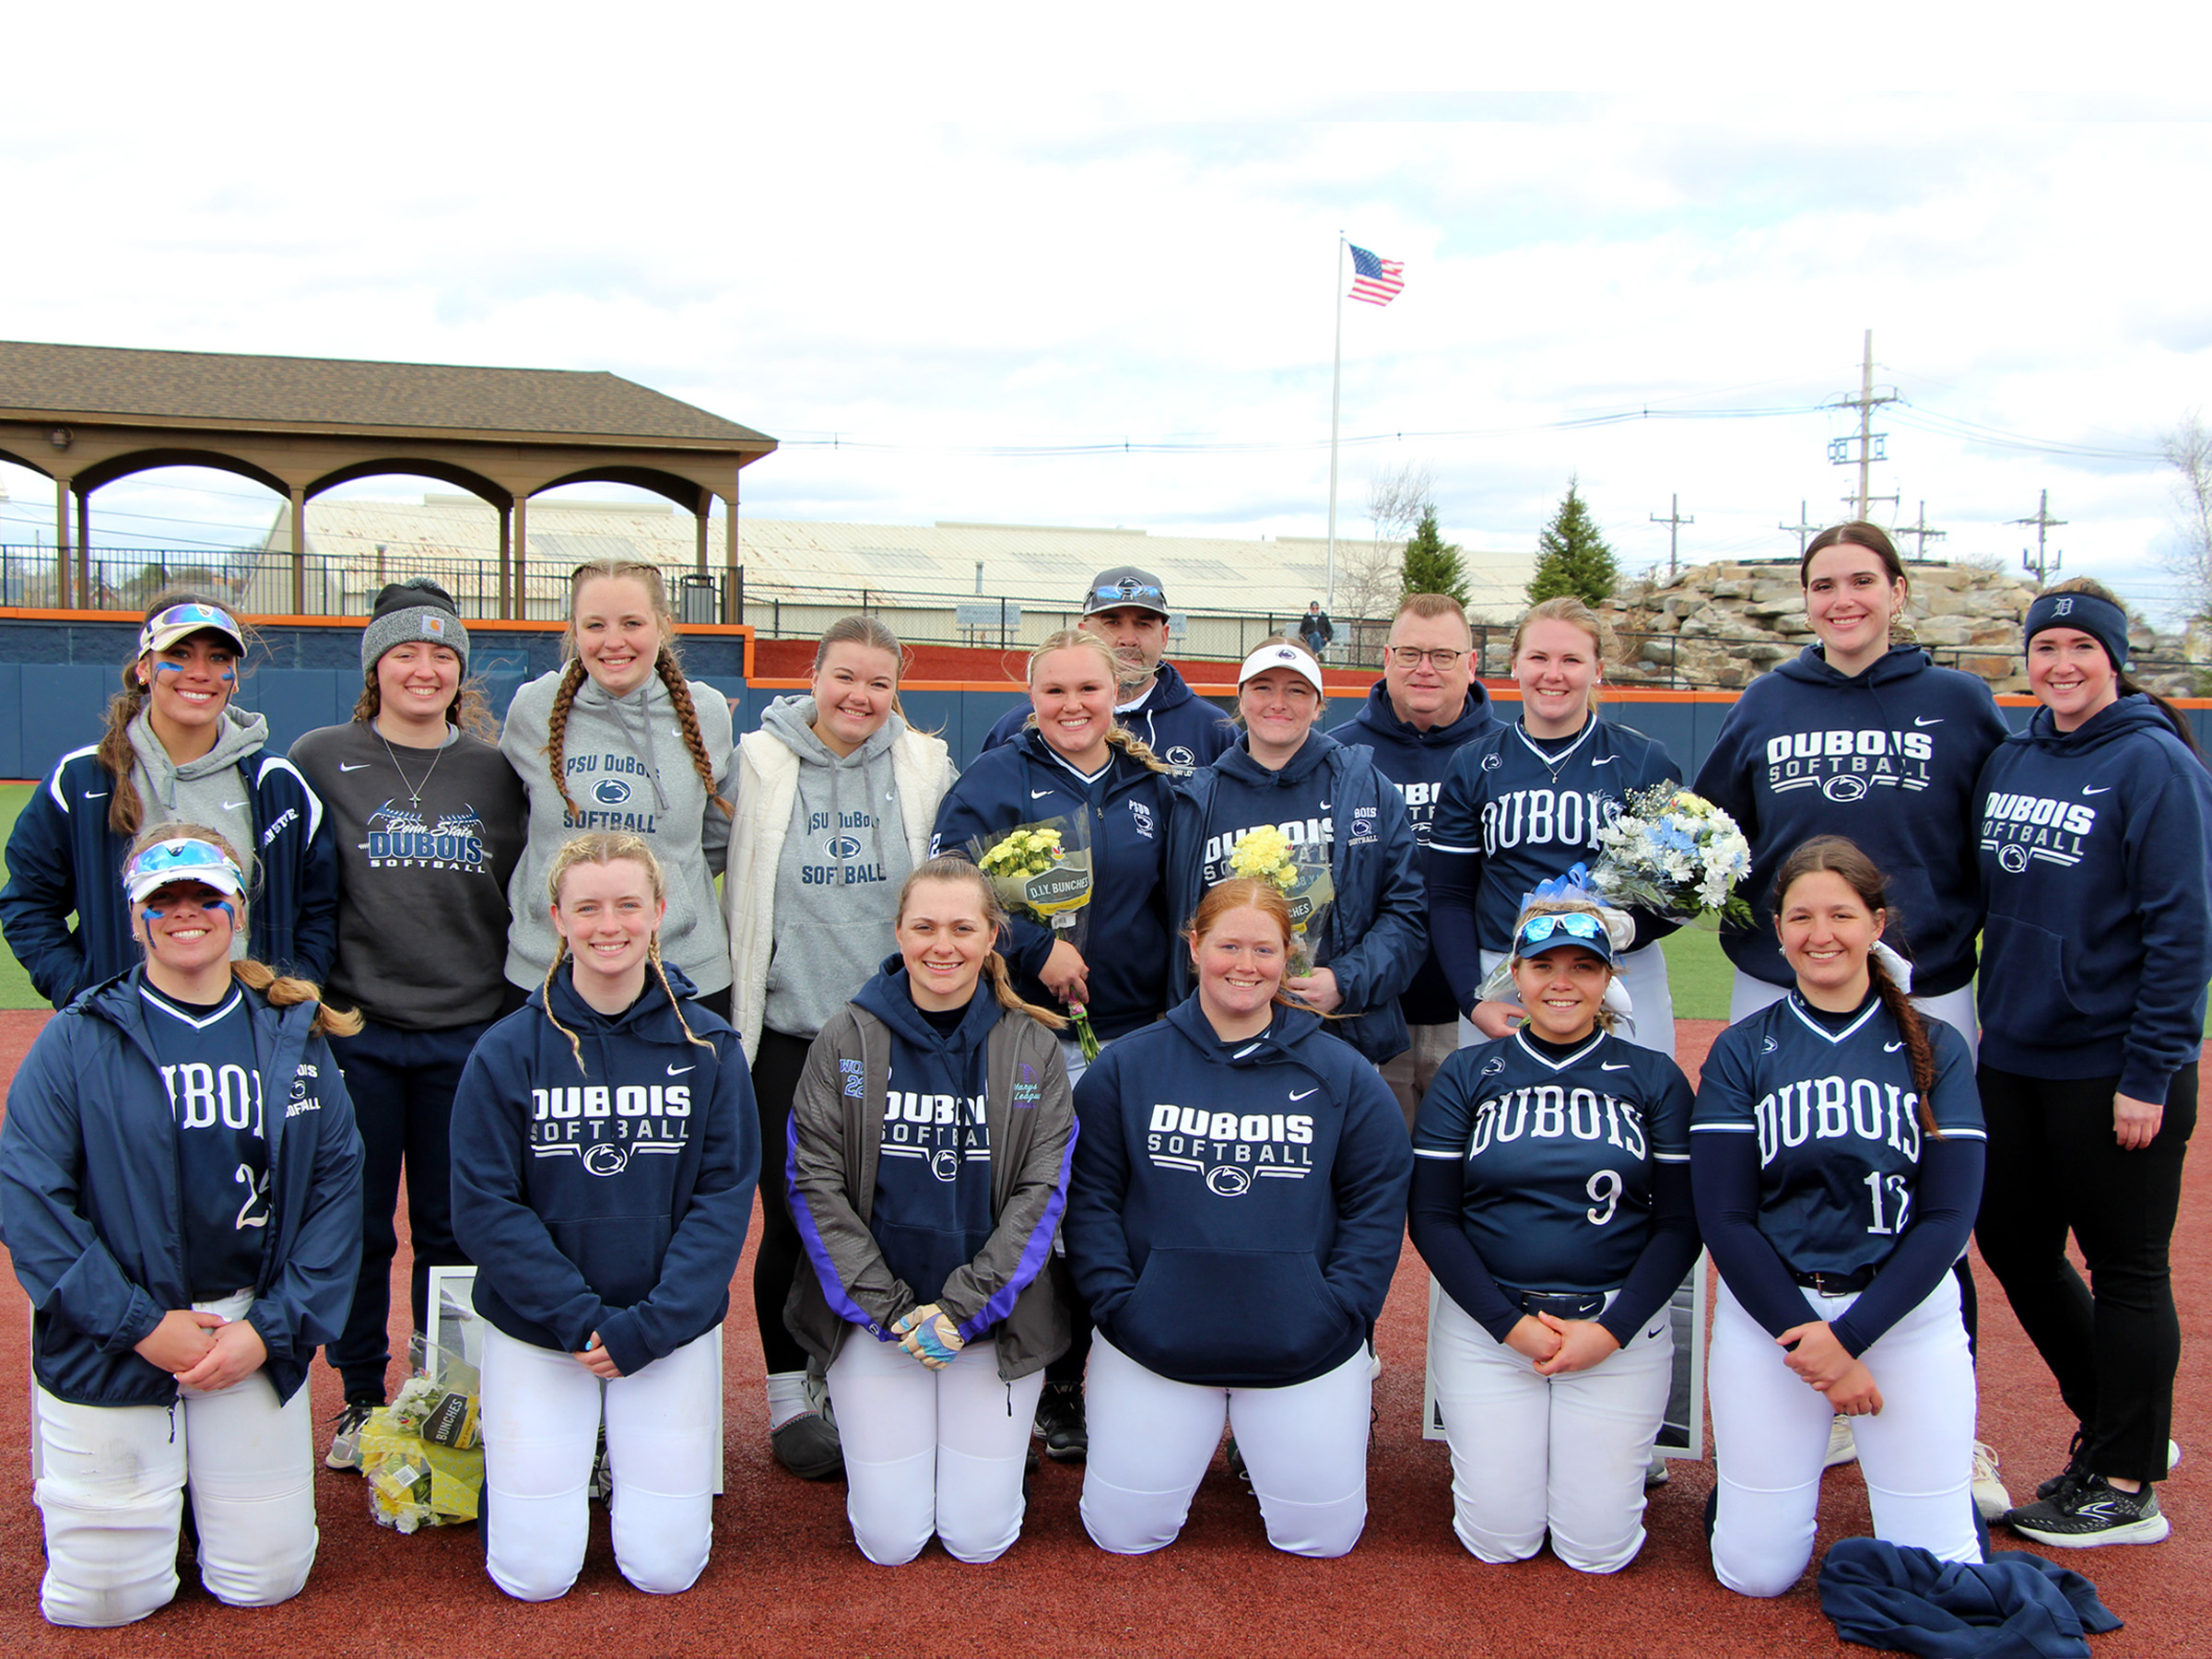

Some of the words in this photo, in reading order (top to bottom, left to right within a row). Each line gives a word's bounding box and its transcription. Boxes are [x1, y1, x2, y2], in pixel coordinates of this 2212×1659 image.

[2051, 597, 2074, 618] D
[1767, 730, 1933, 765] DUBOIS
[567, 754, 597, 776] PSU
[605, 754, 660, 779] DuBo
[386, 818, 428, 834] Penn
[430, 821, 474, 838] State
[563, 810, 656, 833] SOFTBALL
[1354, 807, 1377, 818] BOIS
[1984, 792, 2096, 836] DUBOIS
[369, 830, 483, 865] DUBOIS
[1205, 818, 1334, 864] DUOIS
[1982, 820, 2084, 856] OFTBALL
[371, 859, 486, 874] SOFTBALL
[802, 864, 887, 884] SOFBALL
[1030, 883, 1051, 899] D.I.Y.
[1052, 877, 1088, 894] BUNCHES
[296, 1064, 318, 1077] OIS
[532, 1086, 690, 1121] DUBOIS
[530, 1120, 688, 1142] SOFTBALL
[1149, 1104, 1313, 1145] DUBOIS
[1469, 1085, 1646, 1161] DUBOIS
[1754, 1076, 1920, 1171] DUBOIS
[1147, 1134, 1313, 1165] SOFTBALL
[235, 1163, 271, 1230] 2
[1586, 1170, 1622, 1226] 9
[1864, 1171, 1910, 1234] 12
[435, 1398, 463, 1441] BUNCHES
